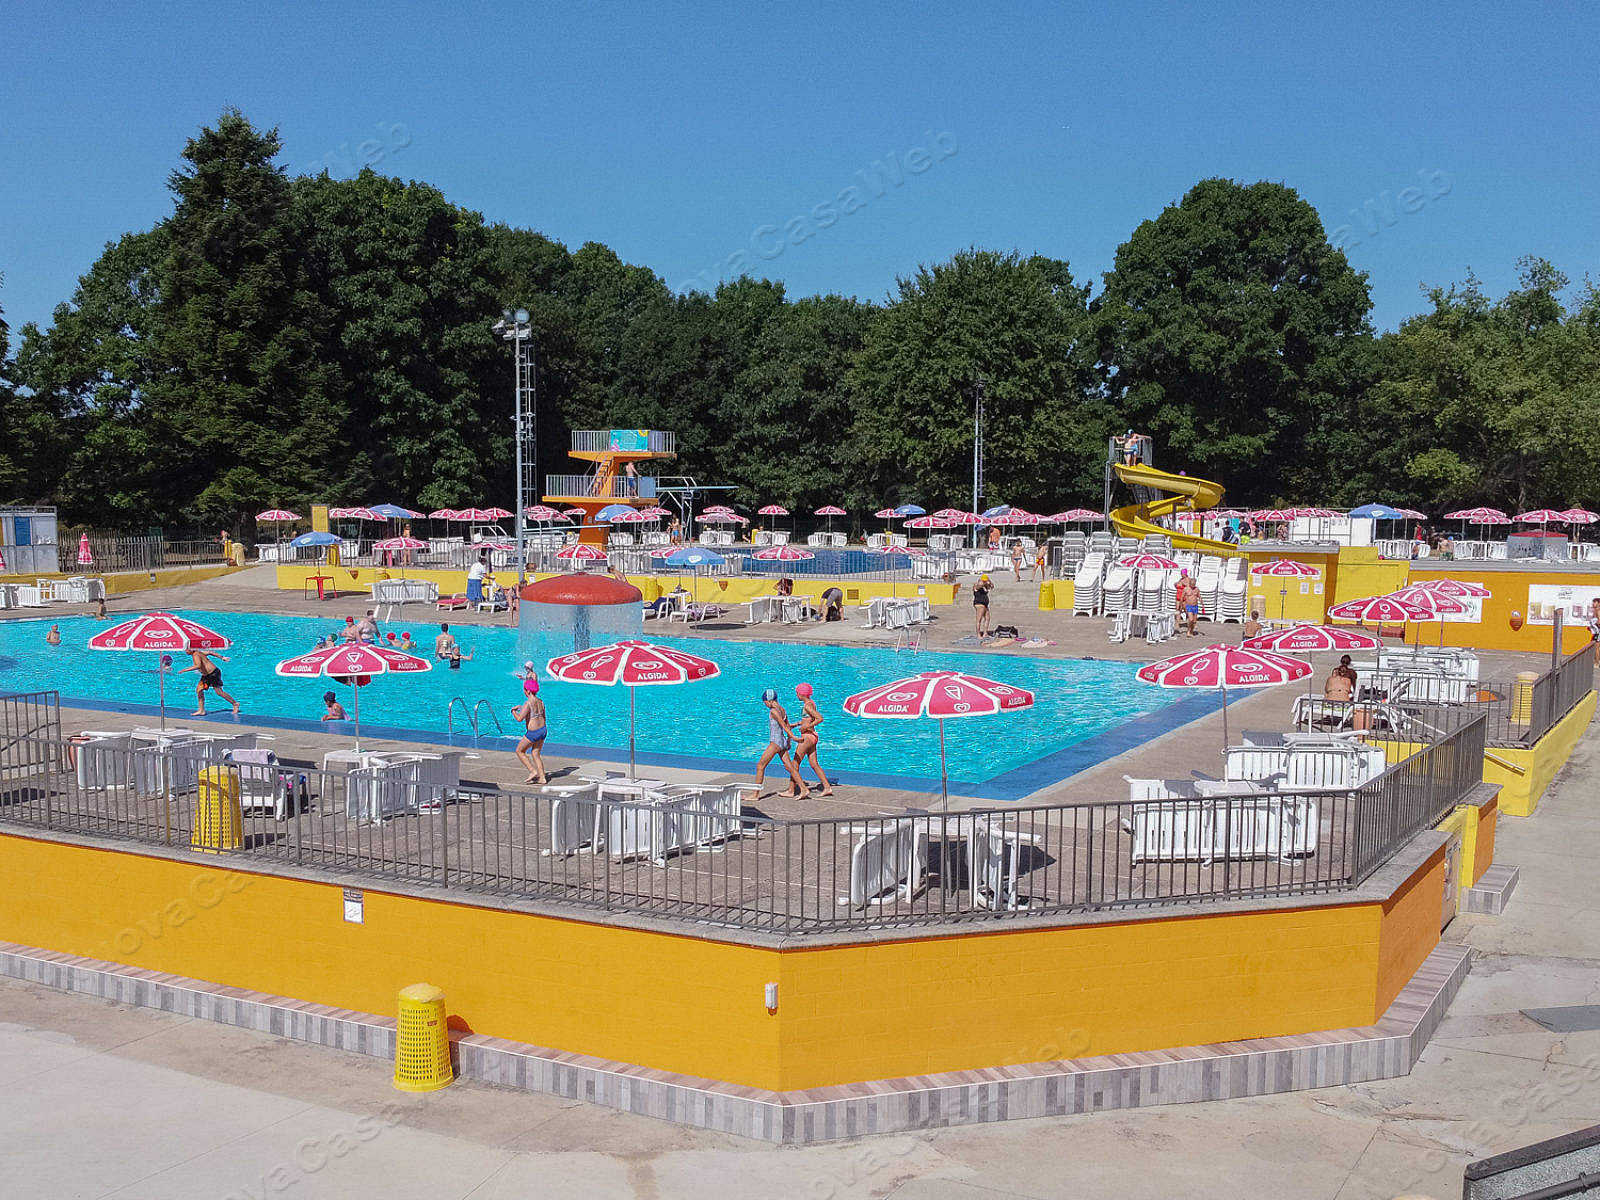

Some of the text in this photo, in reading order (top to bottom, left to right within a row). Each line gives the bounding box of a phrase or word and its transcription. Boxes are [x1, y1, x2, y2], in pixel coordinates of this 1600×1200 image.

[638, 672, 667, 681] ALGIDA
[1239, 674, 1269, 683] ALGIDA
[877, 704, 908, 713] ALGIDA
